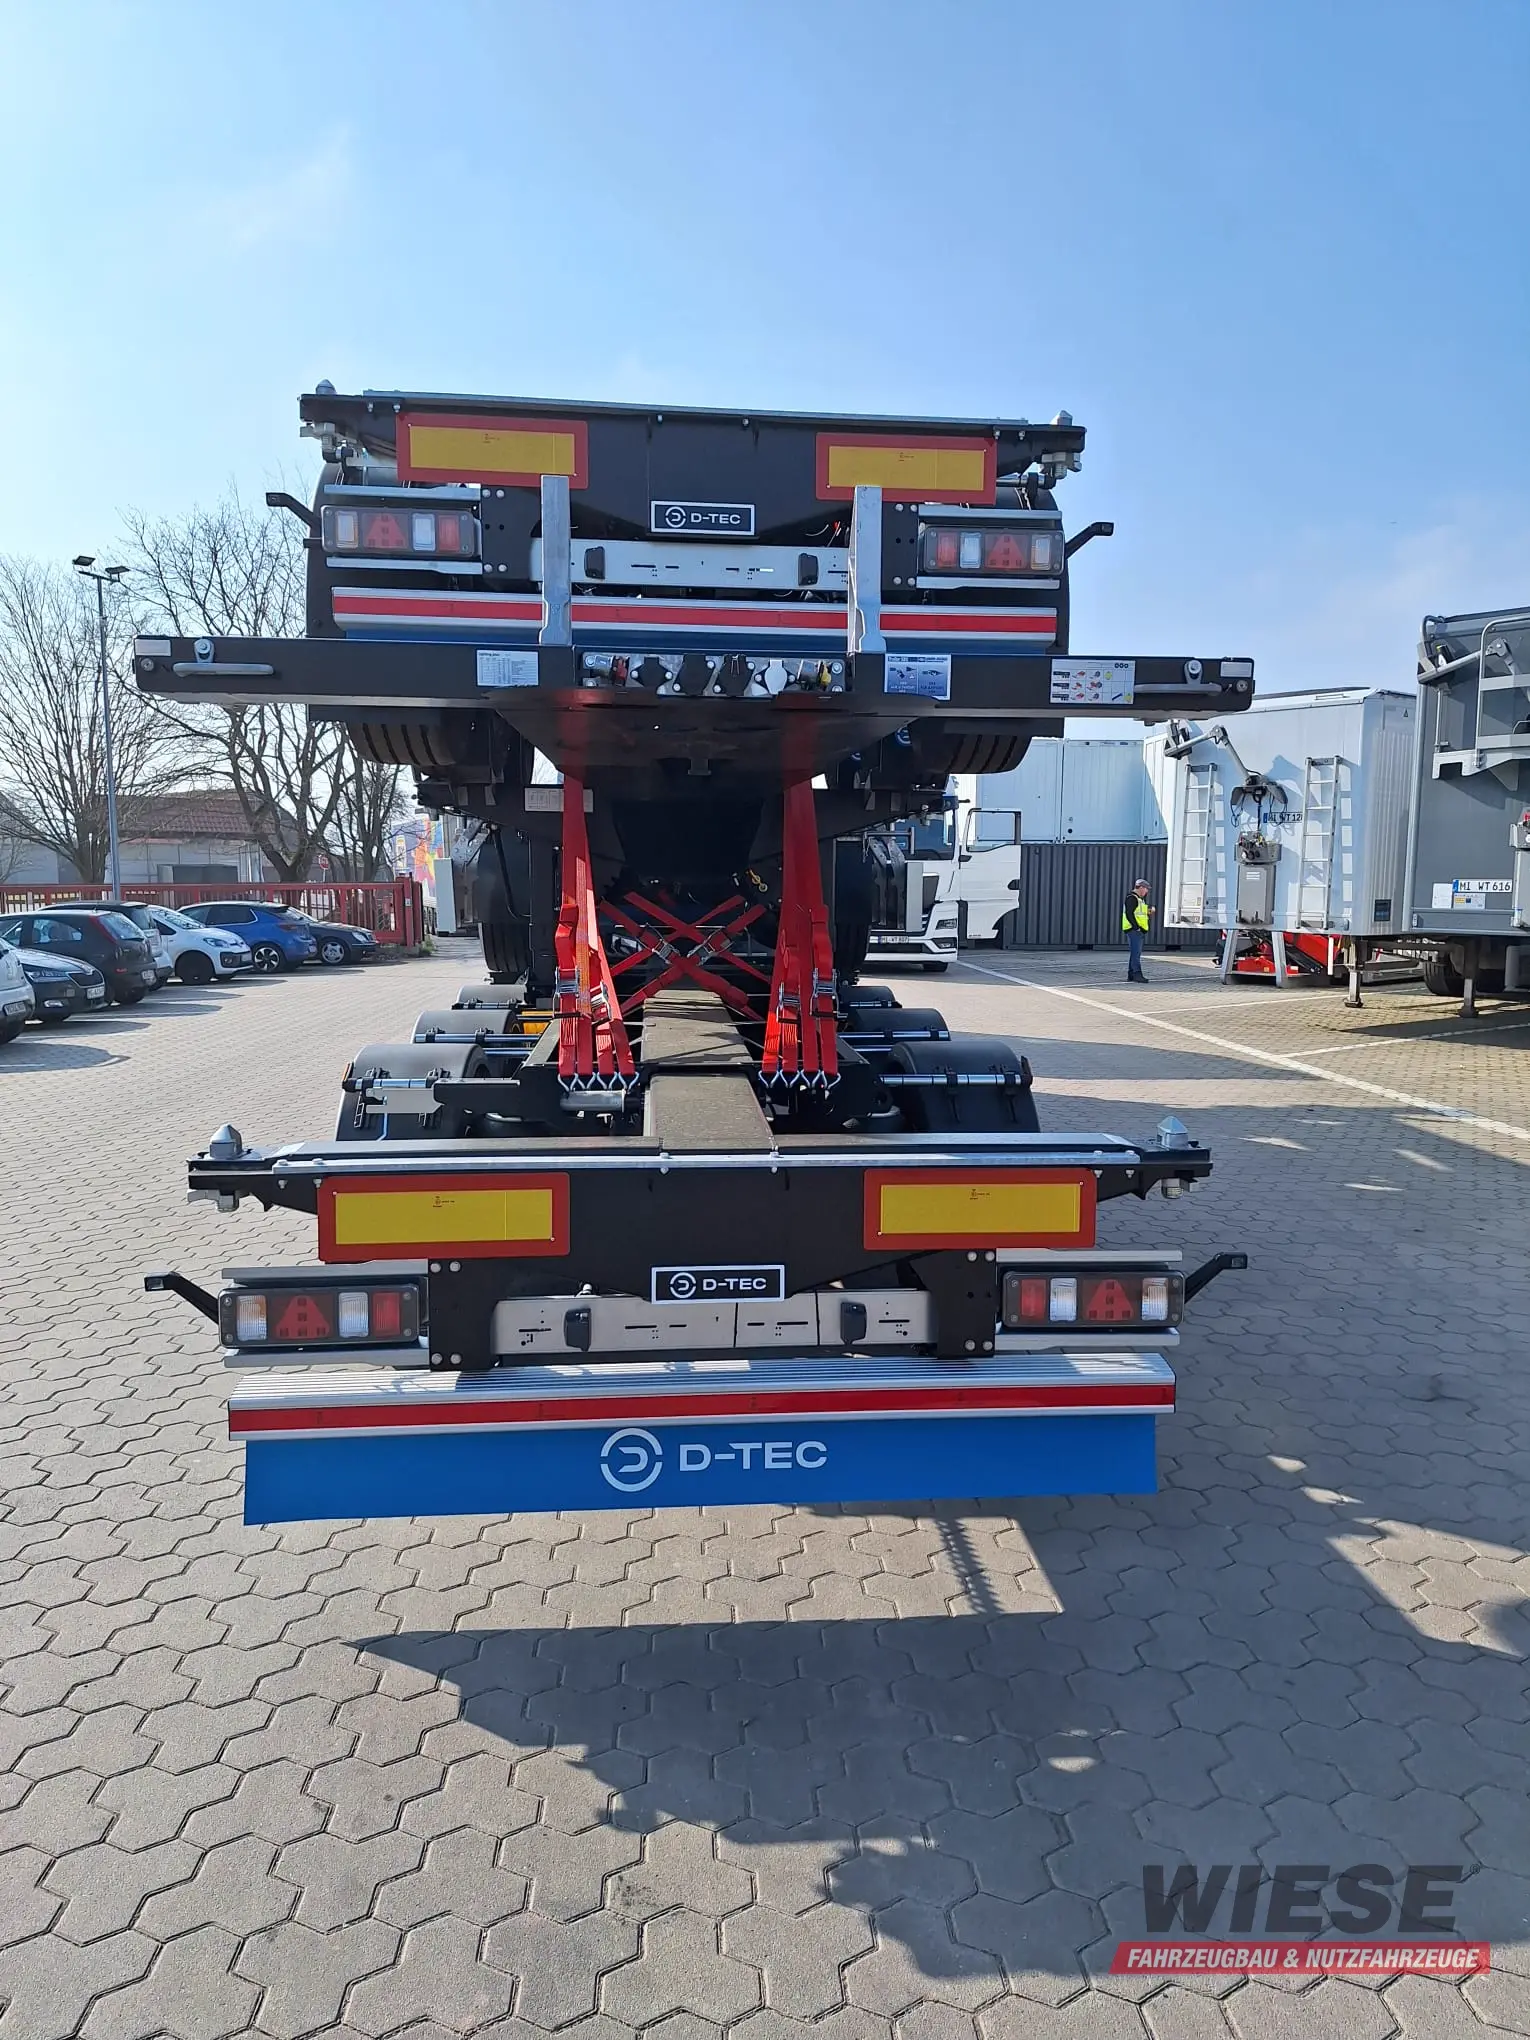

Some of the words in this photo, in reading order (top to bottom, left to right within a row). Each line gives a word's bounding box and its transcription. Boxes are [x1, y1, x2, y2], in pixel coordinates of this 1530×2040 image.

[690, 512, 741, 525] D-TEC
[1460, 882, 1471, 891] MI
[1478, 882, 1490, 891] WT
[1492, 882, 1511, 891] 616
[702, 1277, 767, 1291] D-TEC
[679, 1440, 828, 1472] D-TEC
